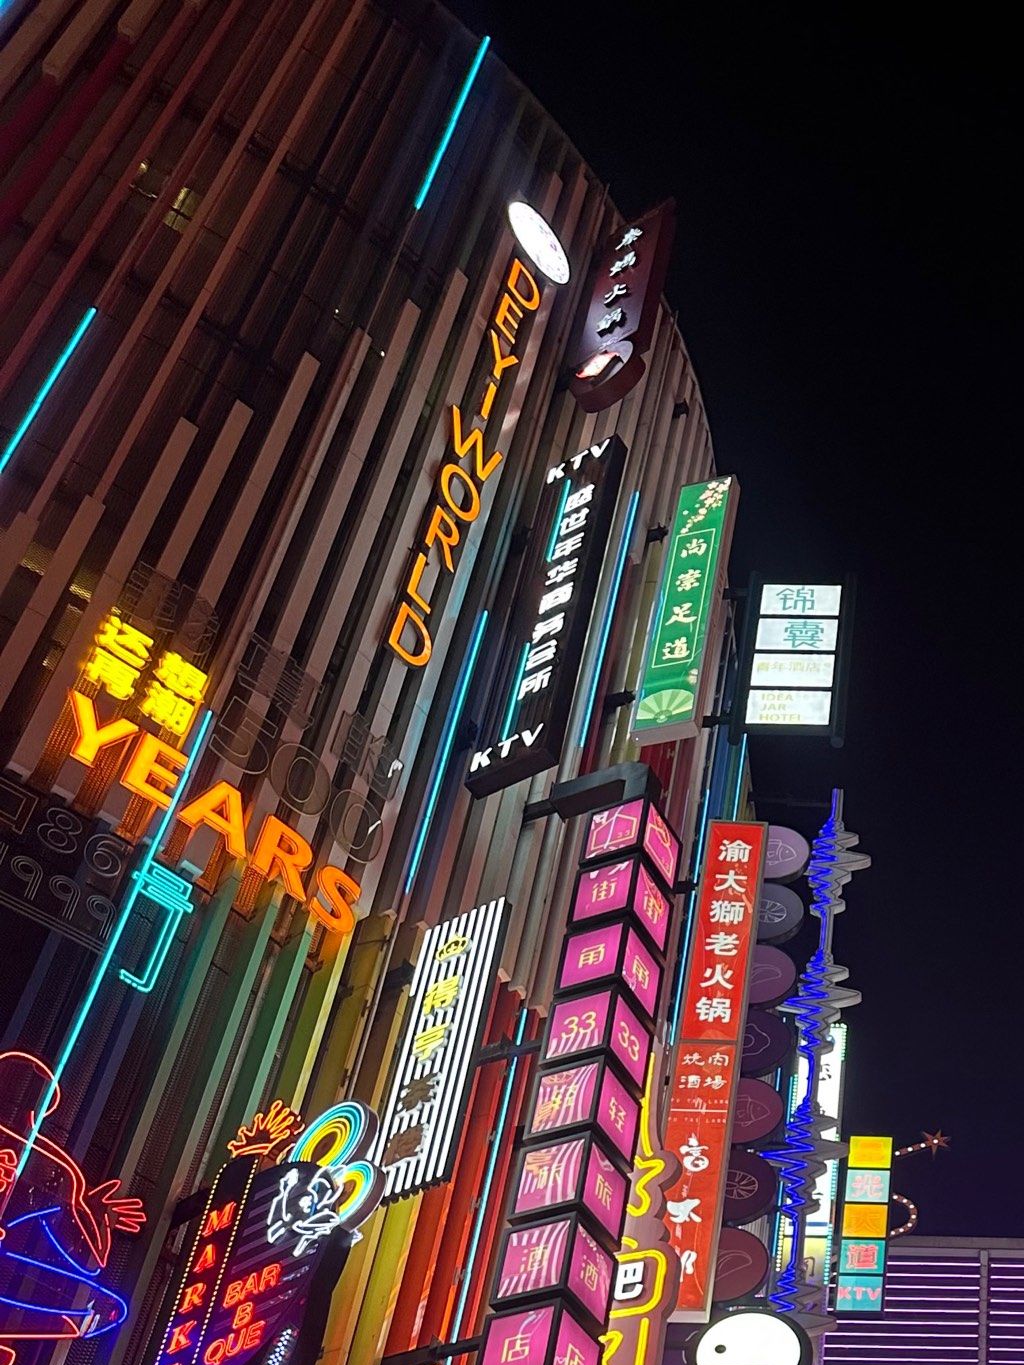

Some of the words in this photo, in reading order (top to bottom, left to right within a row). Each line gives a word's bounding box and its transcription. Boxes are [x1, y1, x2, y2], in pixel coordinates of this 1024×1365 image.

[547, 438, 611, 484] KTV
[517, 484, 595, 701] 盛世年华商务会所
[662, 539, 707, 660] 尚崇足道
[776, 586, 824, 648] 锦囊
[470, 724, 544, 772] KTV
[69, 688, 362, 934] YEARS
[223, 1264, 281, 1308] BAR
[838, 1286, 881, 1300] KTV
[232, 1302, 253, 1329] B
